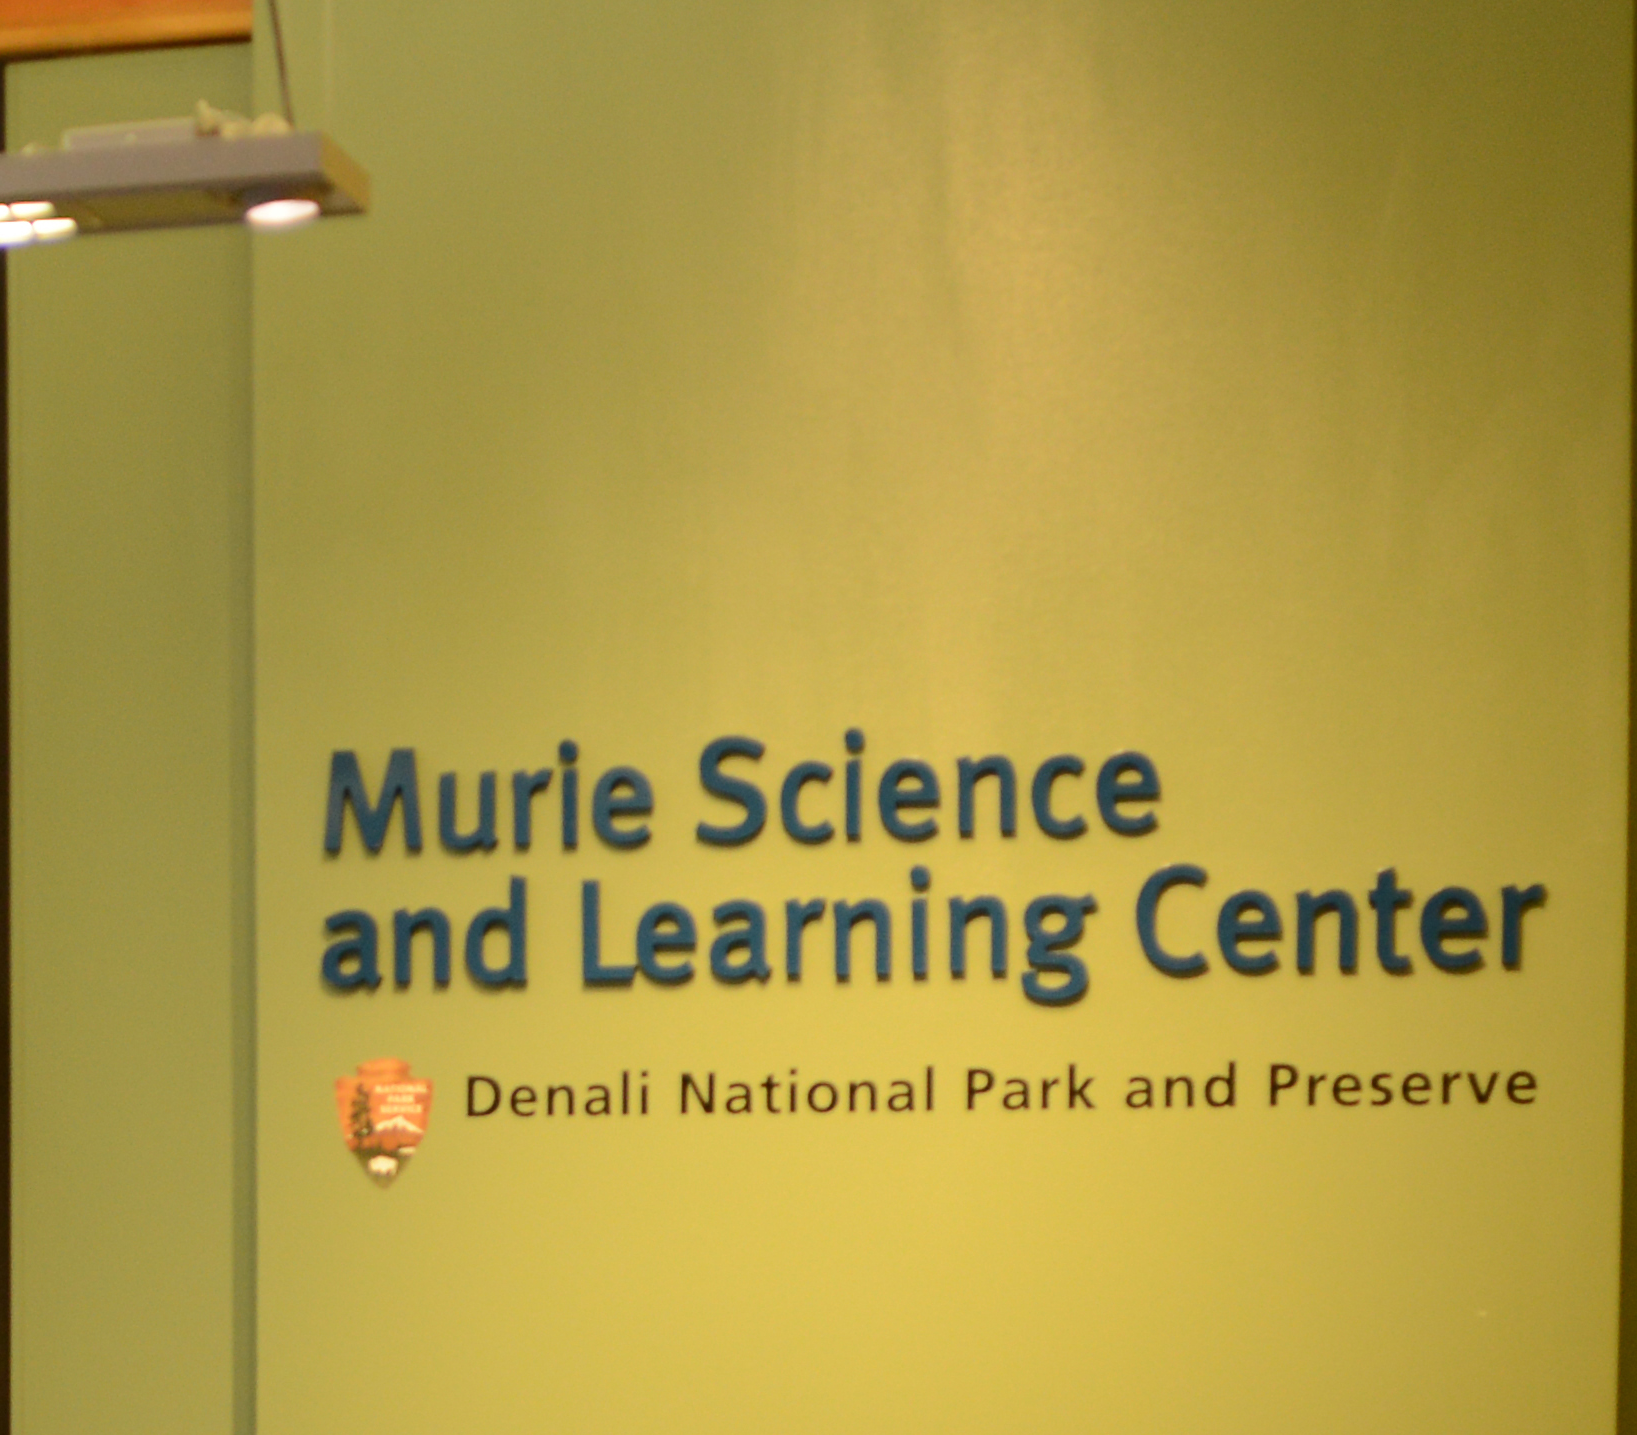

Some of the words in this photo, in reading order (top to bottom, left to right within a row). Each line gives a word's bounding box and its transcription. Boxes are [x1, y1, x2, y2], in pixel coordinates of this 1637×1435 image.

[324, 742, 654, 857] Murie
[695, 730, 1162, 848] Science
[322, 877, 528, 993] and
[582, 866, 1100, 1007] Learning
[1136, 864, 1548, 979] Center
[465, 1070, 649, 1118] Denali
[680, 1066, 935, 1115] National
[966, 1064, 1095, 1111] Park
[1126, 1061, 1237, 1109] and
[1268, 1063, 1538, 1108] Preserve
